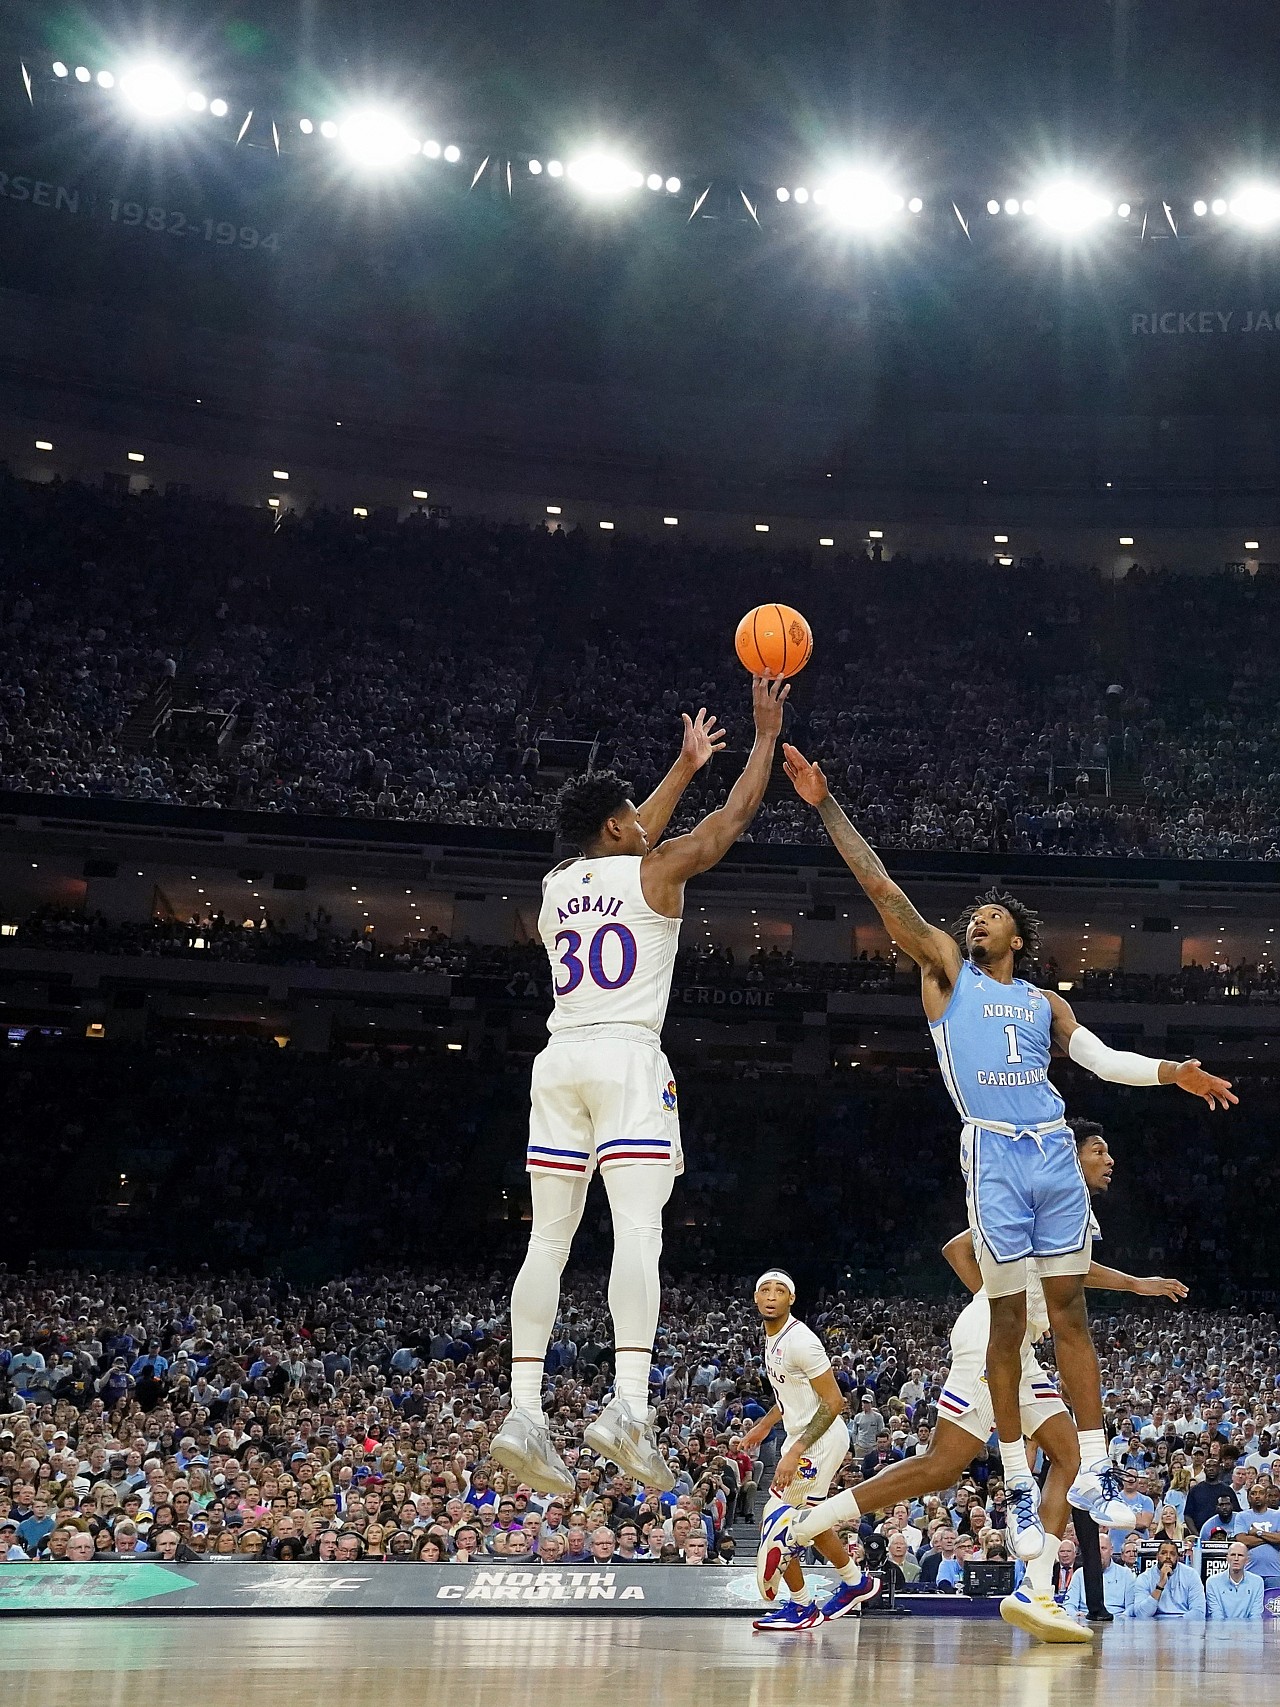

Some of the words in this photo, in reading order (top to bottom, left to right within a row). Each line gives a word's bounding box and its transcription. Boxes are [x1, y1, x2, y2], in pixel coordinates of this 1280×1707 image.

[109, 198, 281, 252] 1982-1994
[1131, 311, 1234, 335] RICKEY
[557, 895, 624, 924] AGBAJI
[554, 922, 638, 996] 30
[983, 1004, 1036, 1024] NORTH
[1003, 1023, 1023, 1065] 1
[977, 1067, 1048, 1087] CAROLINA
[1206, 1560, 1229, 1569] POW
[240, 1577, 374, 1591] ACC
[475, 1572, 616, 1585] NORTH
[436, 1585, 645, 1600] CAROLINA
